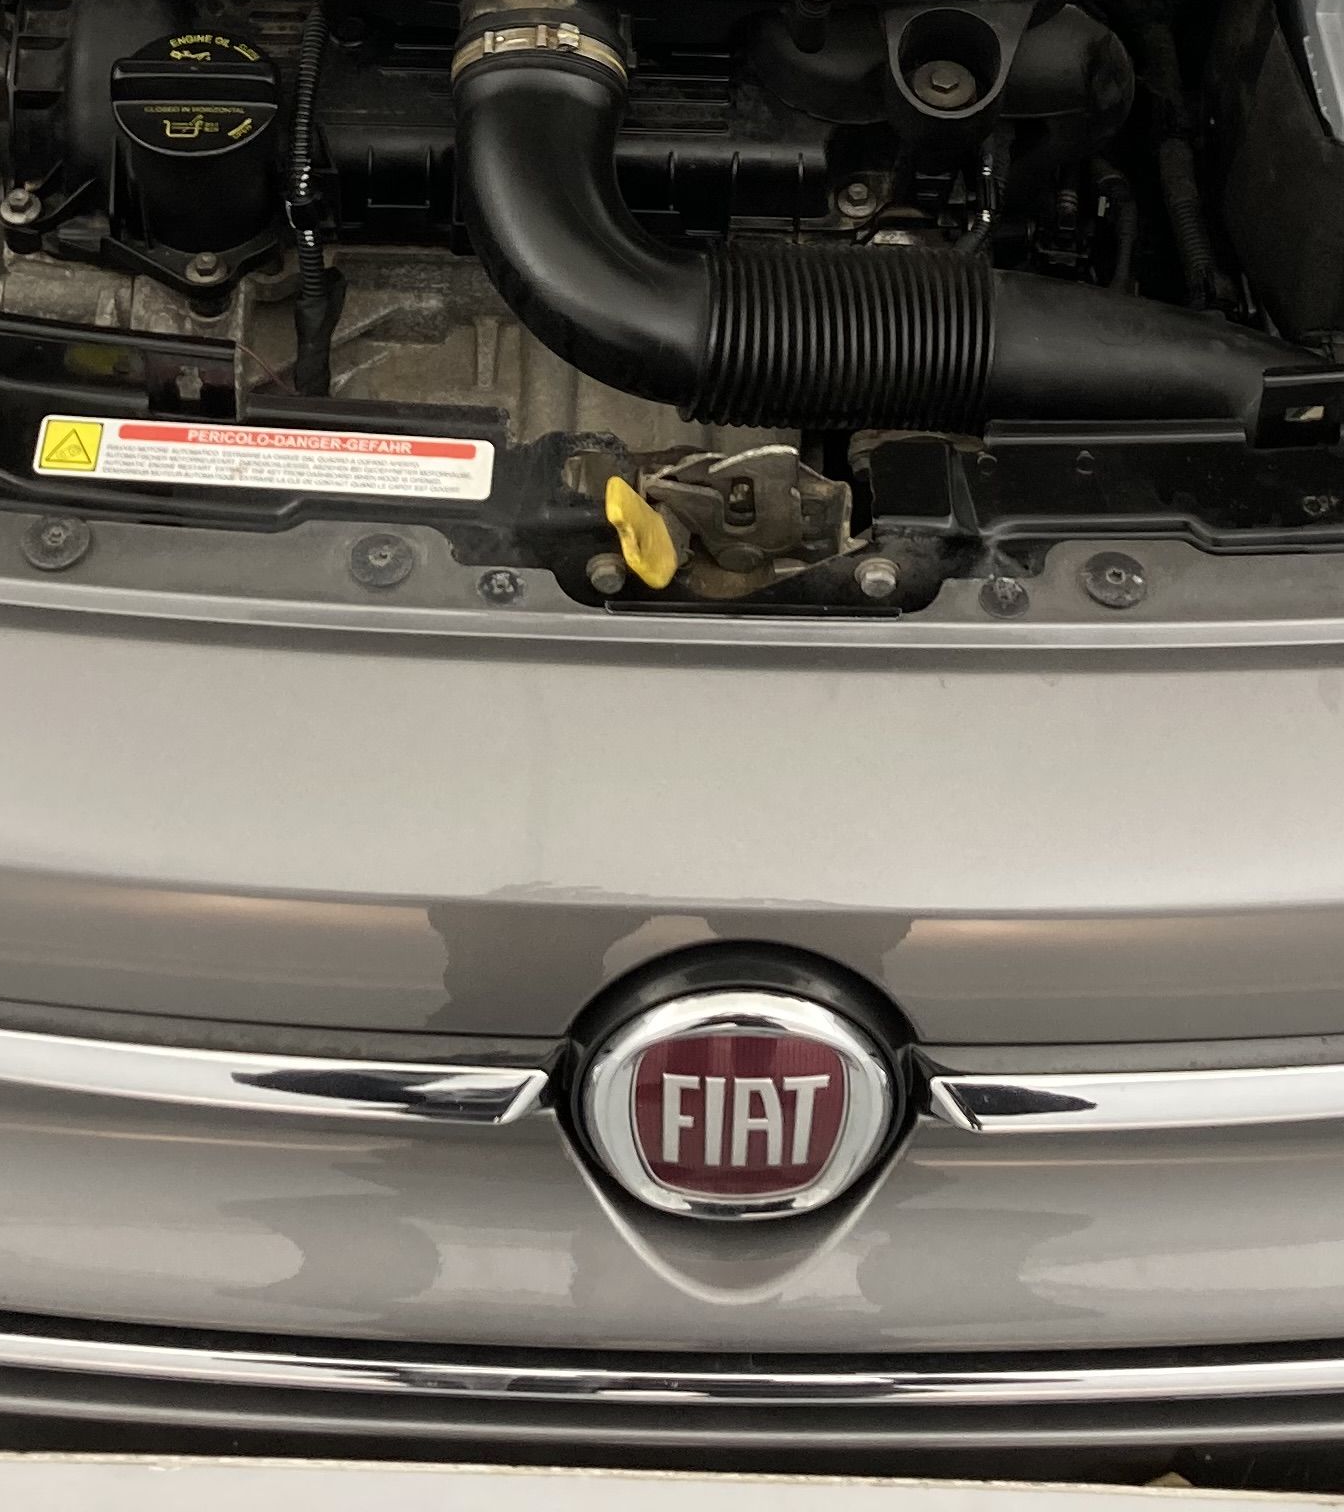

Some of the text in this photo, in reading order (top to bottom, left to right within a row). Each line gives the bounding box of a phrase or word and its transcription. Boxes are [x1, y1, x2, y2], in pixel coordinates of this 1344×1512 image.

[169, 34, 213, 48] ENGINE
[187, 429, 413, 456] PERICOLO-DANGER-GEFAHR
[662, 1072, 831, 1167] FIAT
